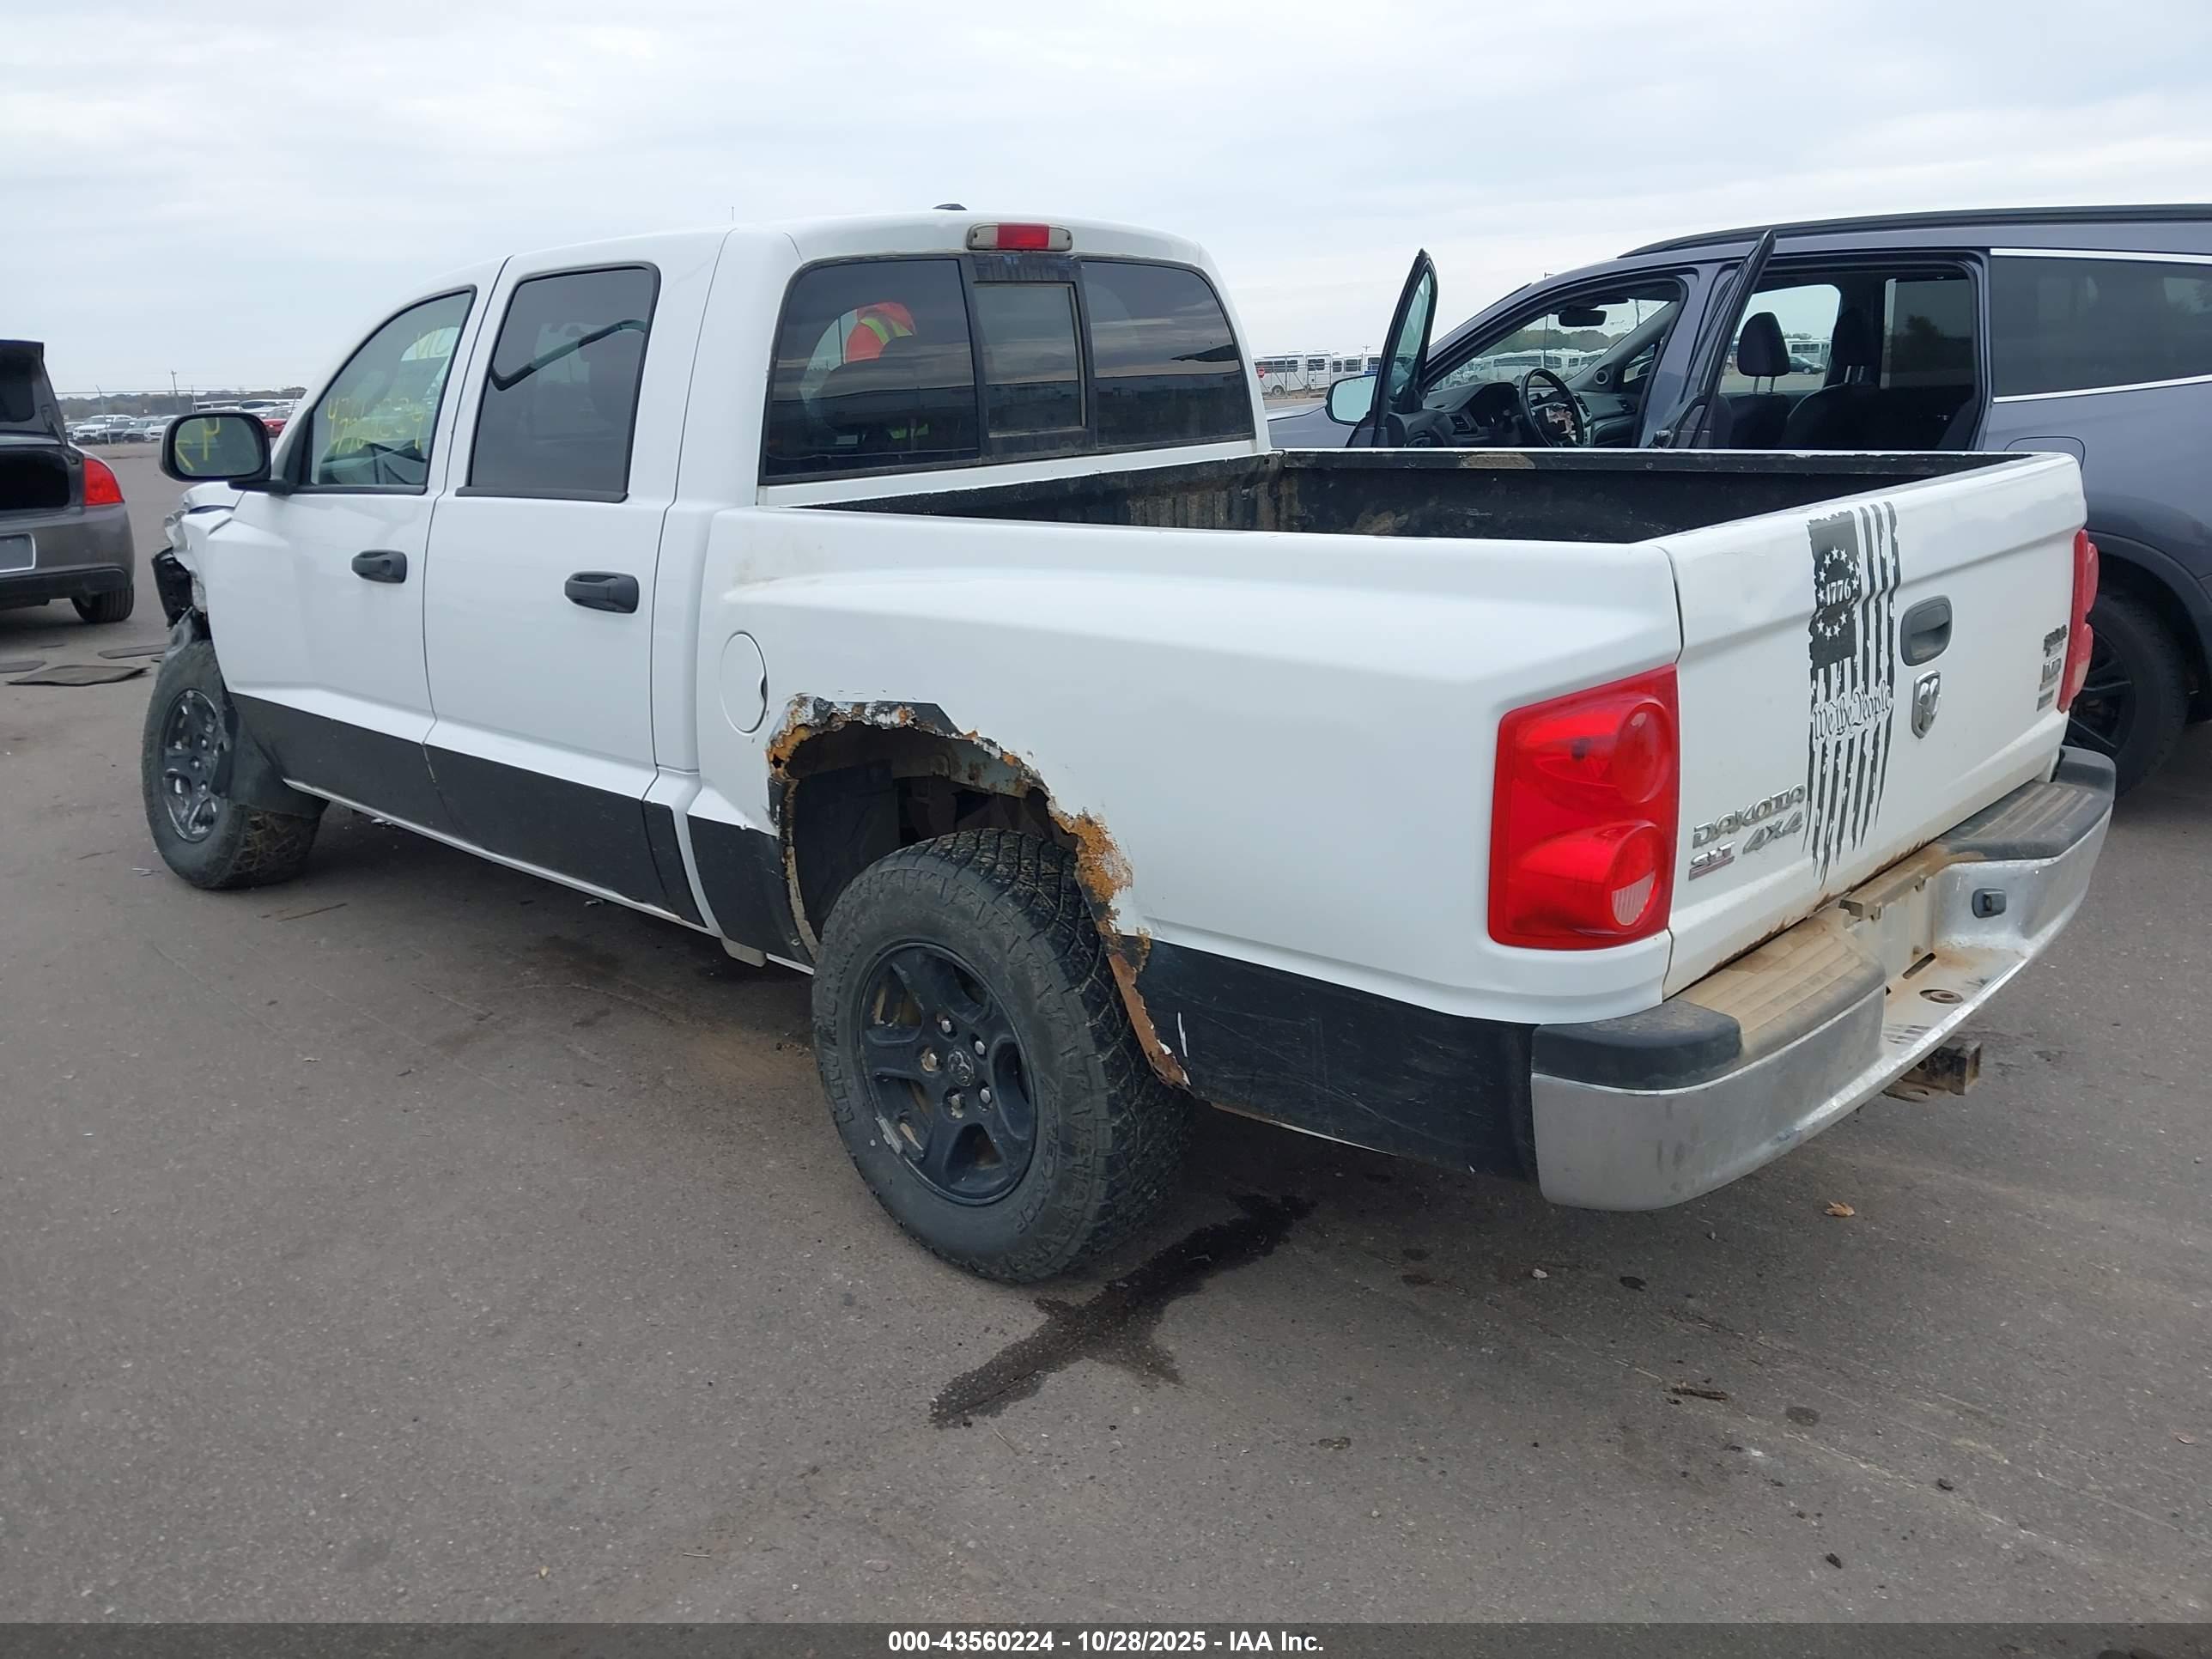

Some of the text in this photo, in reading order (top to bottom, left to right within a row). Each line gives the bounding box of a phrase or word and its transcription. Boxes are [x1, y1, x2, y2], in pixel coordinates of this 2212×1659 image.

[1826, 578, 1851, 606] 1776
[1852, 679, 1891, 726] People
[1692, 783, 1806, 849] DAKOTA
[1690, 842, 1735, 867] SLT
